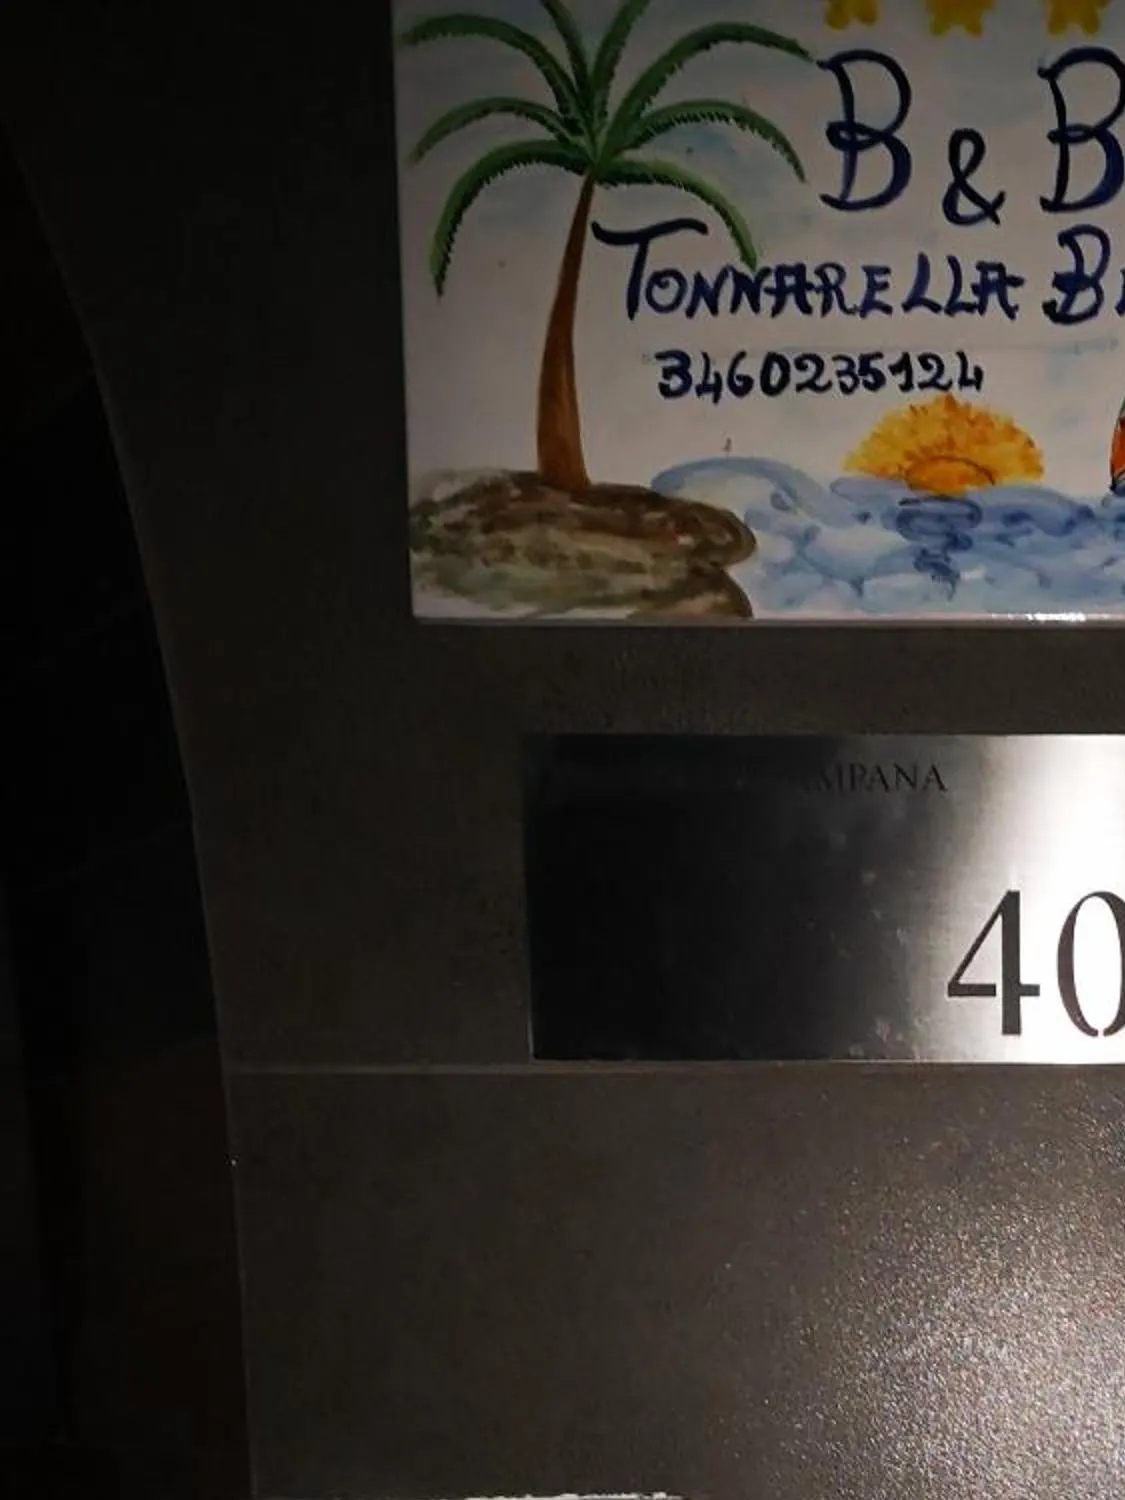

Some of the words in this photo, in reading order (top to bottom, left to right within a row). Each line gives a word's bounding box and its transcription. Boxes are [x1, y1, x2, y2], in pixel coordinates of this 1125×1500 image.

[816, 49, 912, 212] B
[942, 127, 1006, 226] &
[591, 217, 1025, 321] TONNARELLA
[654, 349, 984, 403] 3460235124
